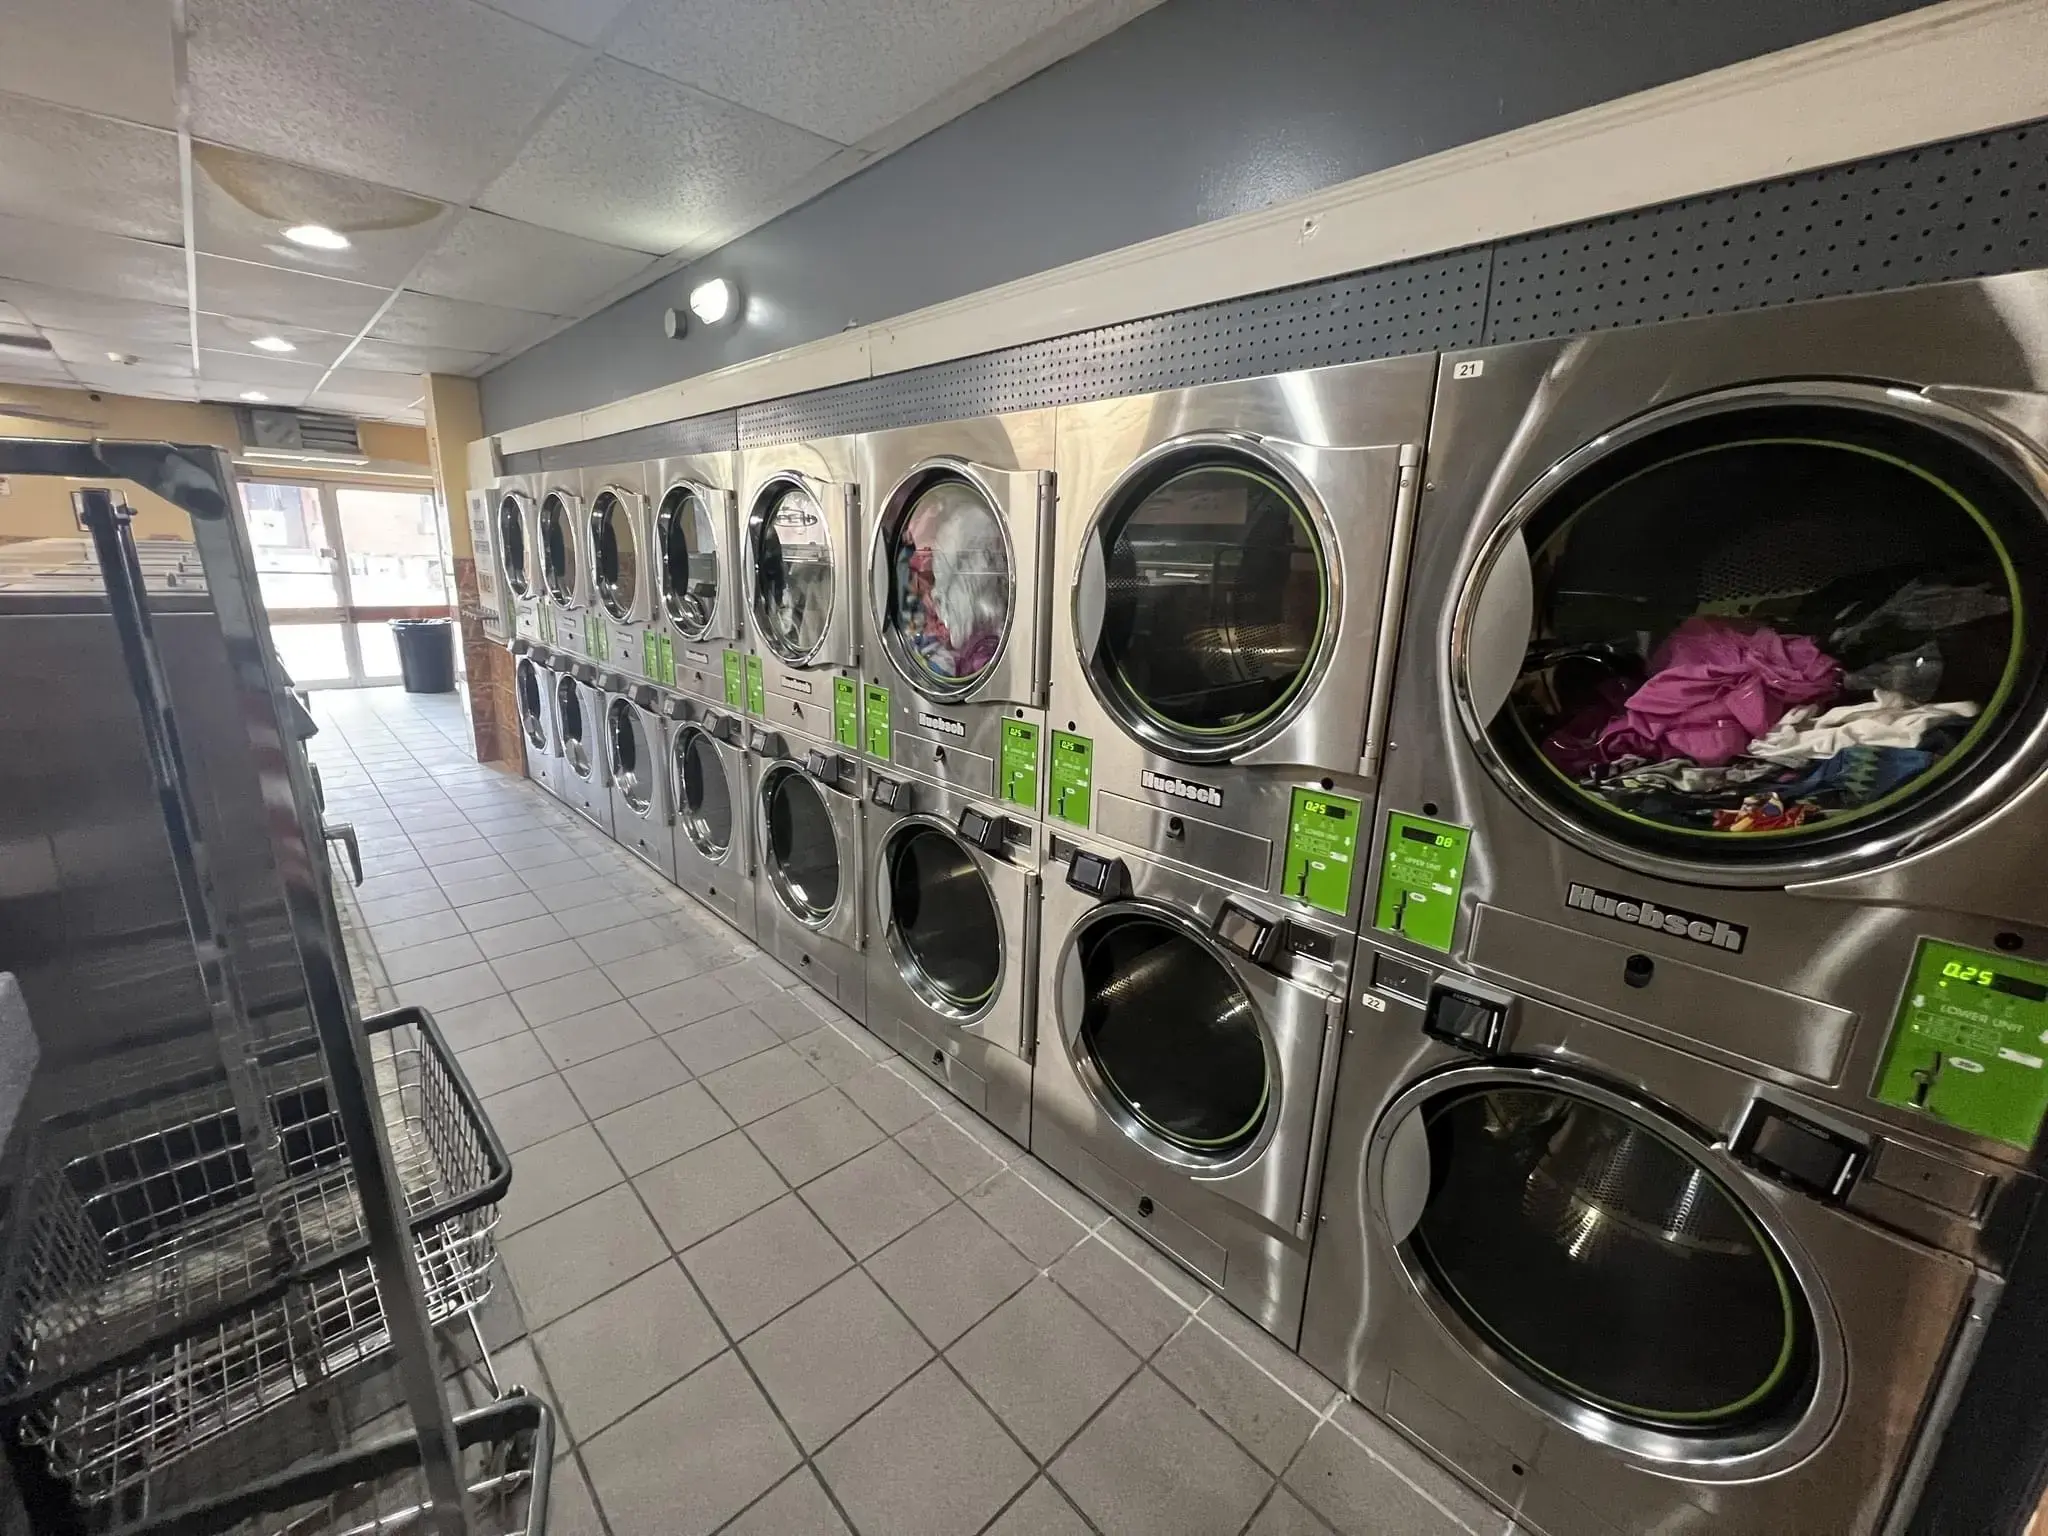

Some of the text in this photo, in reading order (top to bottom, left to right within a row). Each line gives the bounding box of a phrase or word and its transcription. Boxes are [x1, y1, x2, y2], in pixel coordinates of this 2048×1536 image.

[1460, 363, 1475, 376] 21
[1142, 770, 1221, 807] Huebsch
[1435, 835, 1453, 848] 08
[1568, 884, 1742, 951] Huebsch
[1367, 997, 1380, 1009] 22
